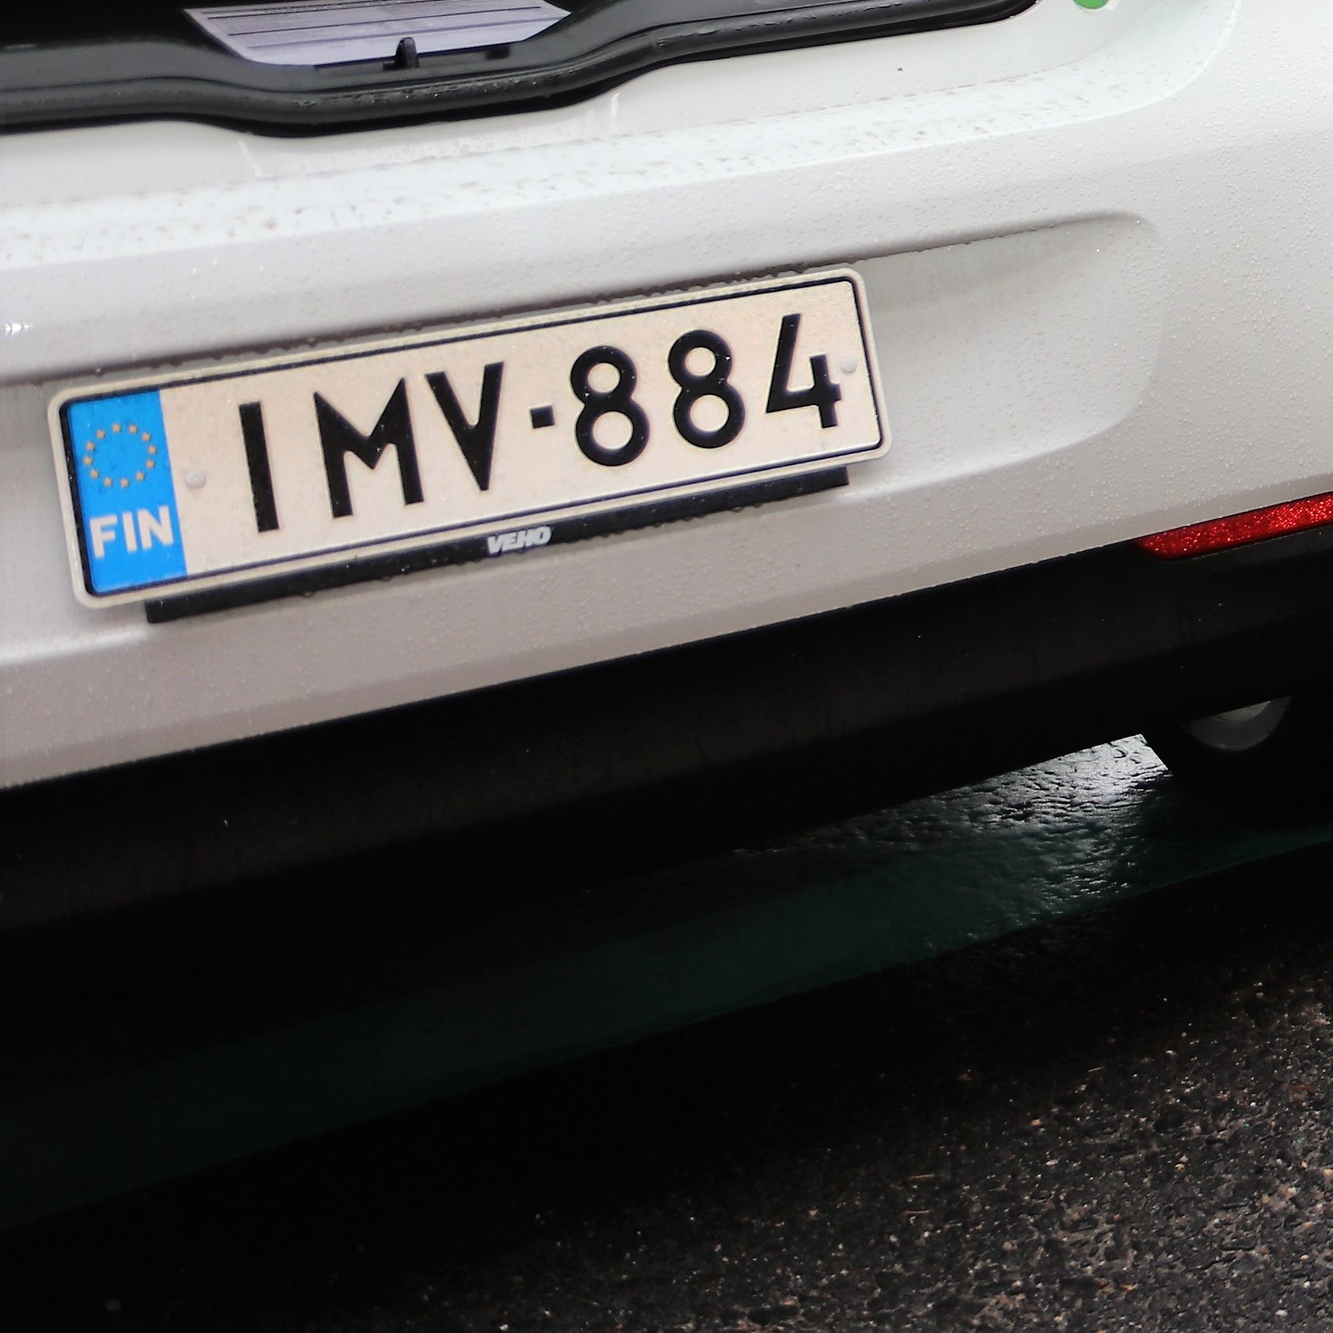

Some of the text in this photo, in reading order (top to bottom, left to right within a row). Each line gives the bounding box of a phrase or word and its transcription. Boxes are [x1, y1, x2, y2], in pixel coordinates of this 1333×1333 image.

[239, 314, 843, 533] IMV-884
[90, 505, 174, 559] FIN
[487, 525, 552, 554] VEHO
